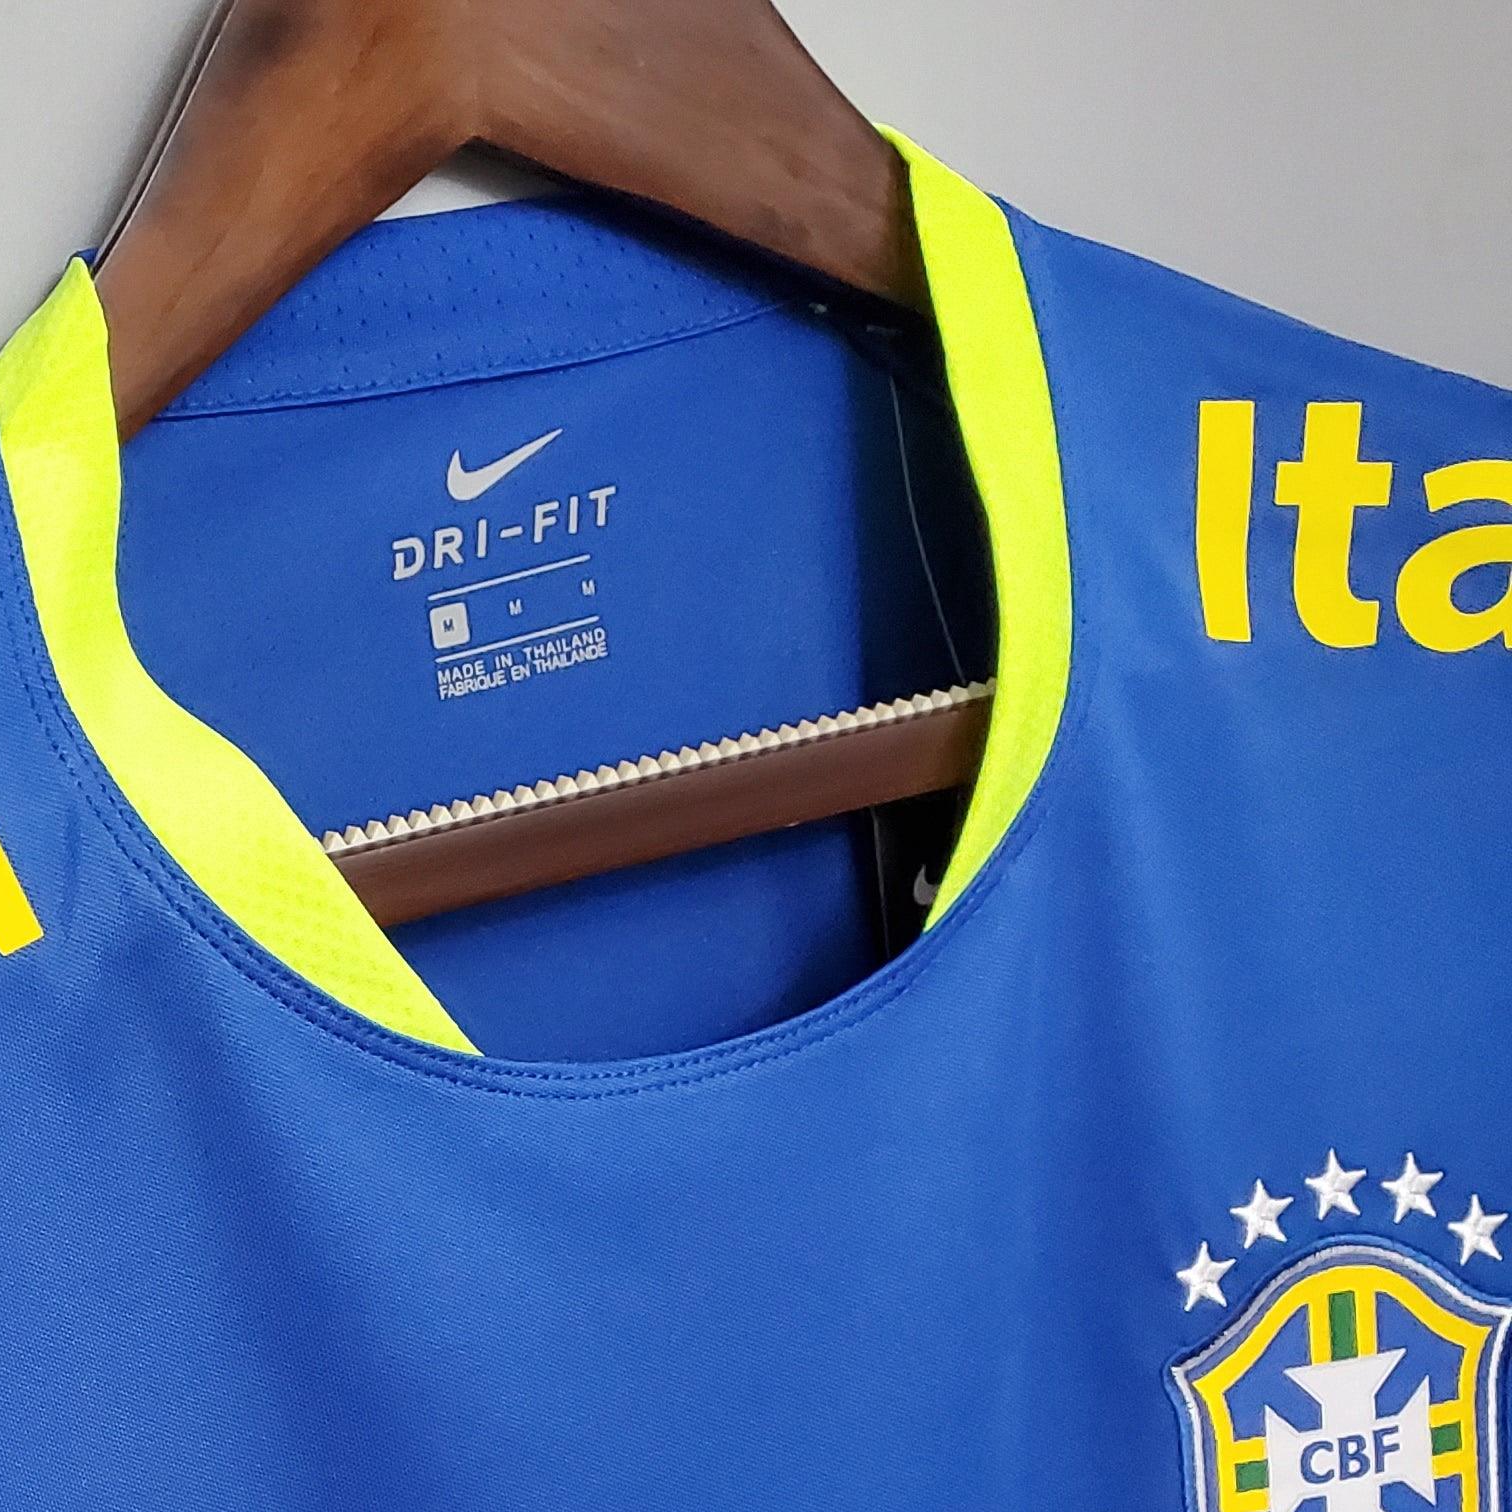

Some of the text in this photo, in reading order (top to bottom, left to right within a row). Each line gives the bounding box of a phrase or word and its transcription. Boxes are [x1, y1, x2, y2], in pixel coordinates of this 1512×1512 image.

[392, 485, 617, 581] DRI-FIT
[443, 580, 595, 632] M M M
[438, 627, 607, 685] MADE IN THAILAND
[439, 643, 608, 700] FABRIQUE EN THAILANDE
[1299, 1426, 1402, 1485] CBF
